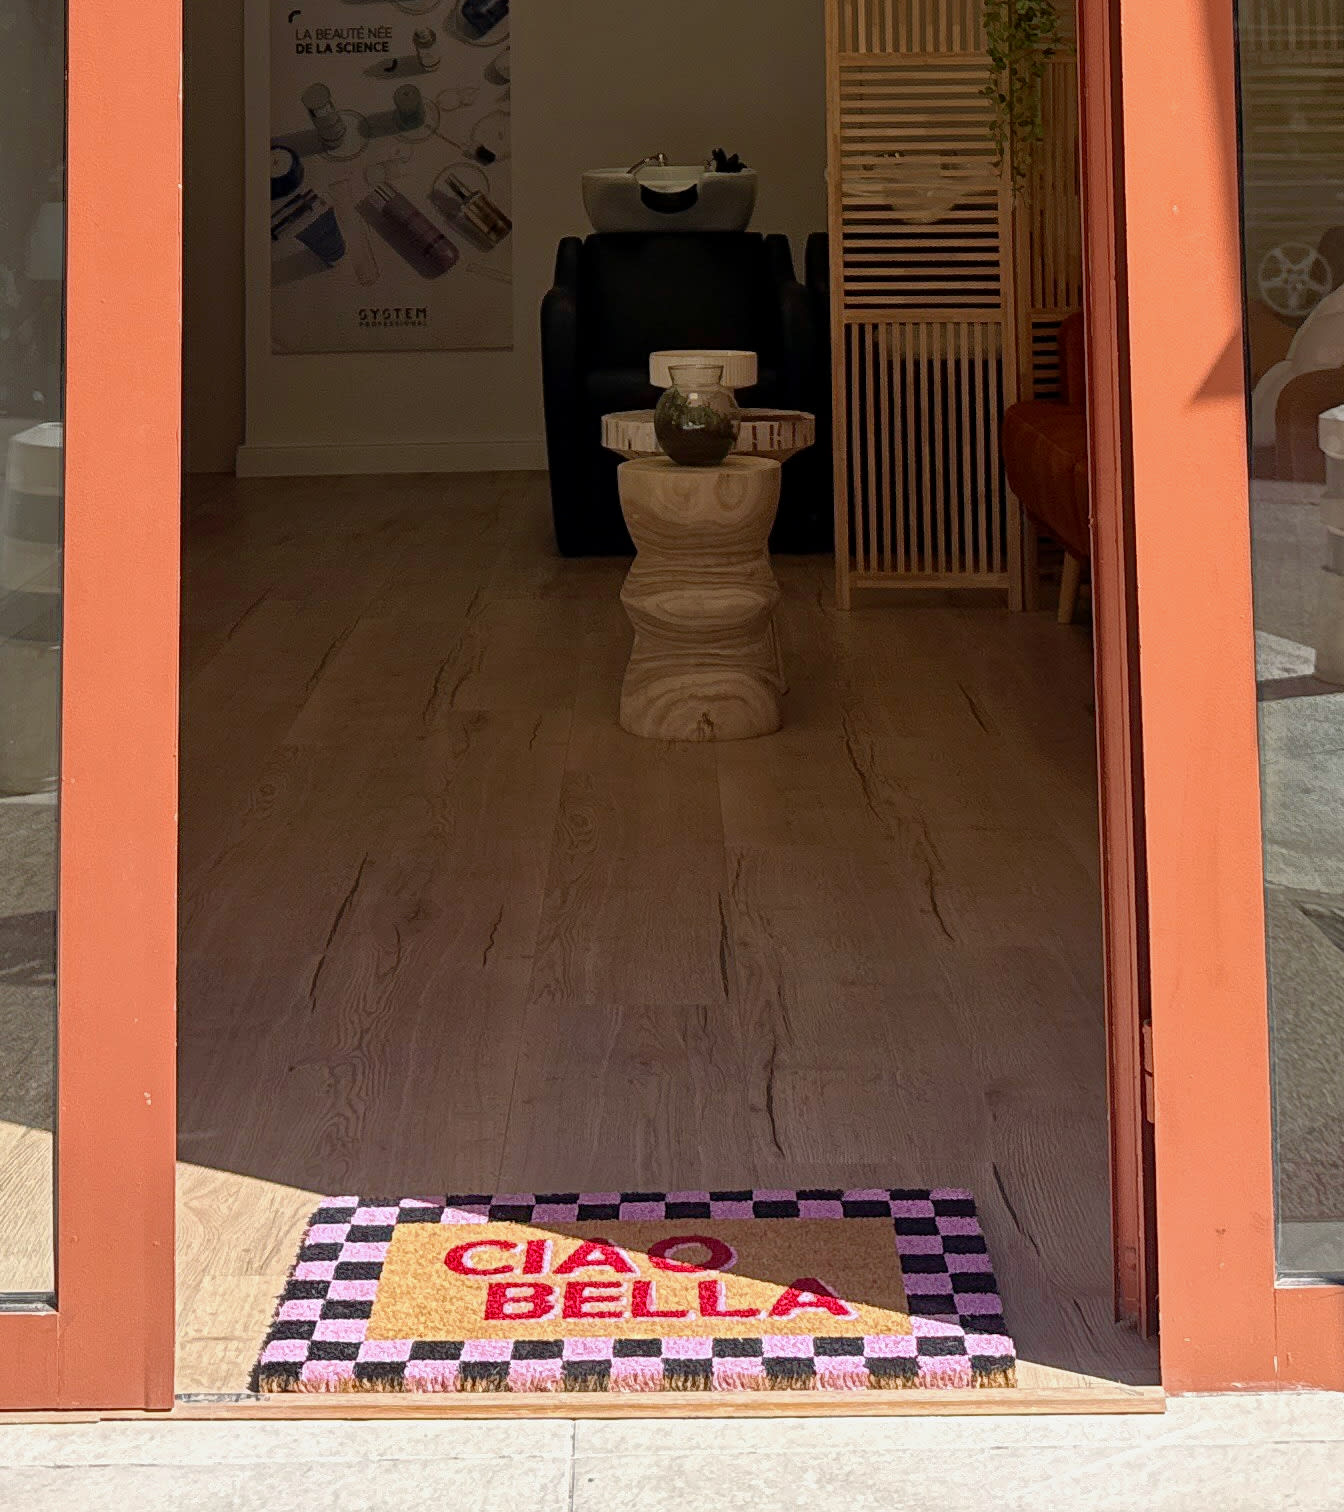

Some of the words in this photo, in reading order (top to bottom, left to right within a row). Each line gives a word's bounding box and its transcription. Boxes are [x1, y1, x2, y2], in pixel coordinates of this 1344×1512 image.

[296, 29, 312, 40] LA
[316, 25, 364, 40] BEAUTÉ
[368, 25, 393, 39] NÉE
[295, 43, 313, 54] DE
[316, 42, 333, 54] LA
[336, 41, 390, 54] SCIENCE
[358, 308, 427, 320] SYSTEM
[444, 1235, 738, 1277] CIAO
[482, 1278, 860, 1322] BELLA
